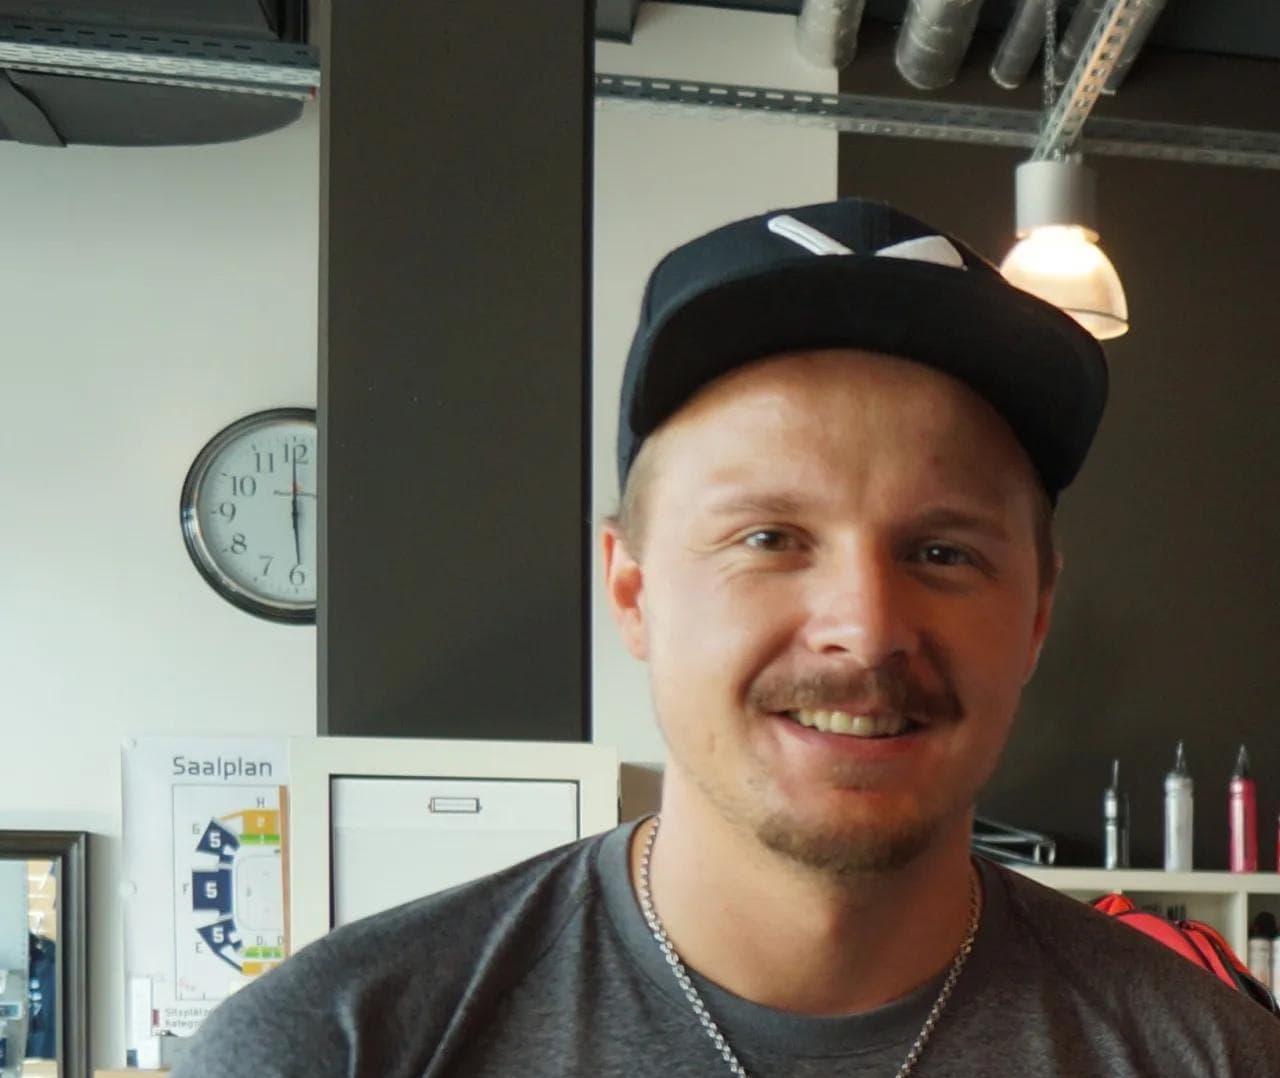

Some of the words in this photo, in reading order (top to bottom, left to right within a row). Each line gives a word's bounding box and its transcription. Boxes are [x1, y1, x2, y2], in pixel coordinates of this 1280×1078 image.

[254, 452, 274, 473] 11
[284, 443, 309, 465] 12
[231, 475, 257, 497] 10
[219, 502, 237, 524] 9
[230, 533, 248, 555] 8
[258, 555, 275, 577] 7
[288, 564, 306, 586] 6
[172, 755, 273, 781] Saalplan
[209, 832, 221, 849] 5
[205, 881, 218, 898] 5
[212, 927, 224, 943] 5
